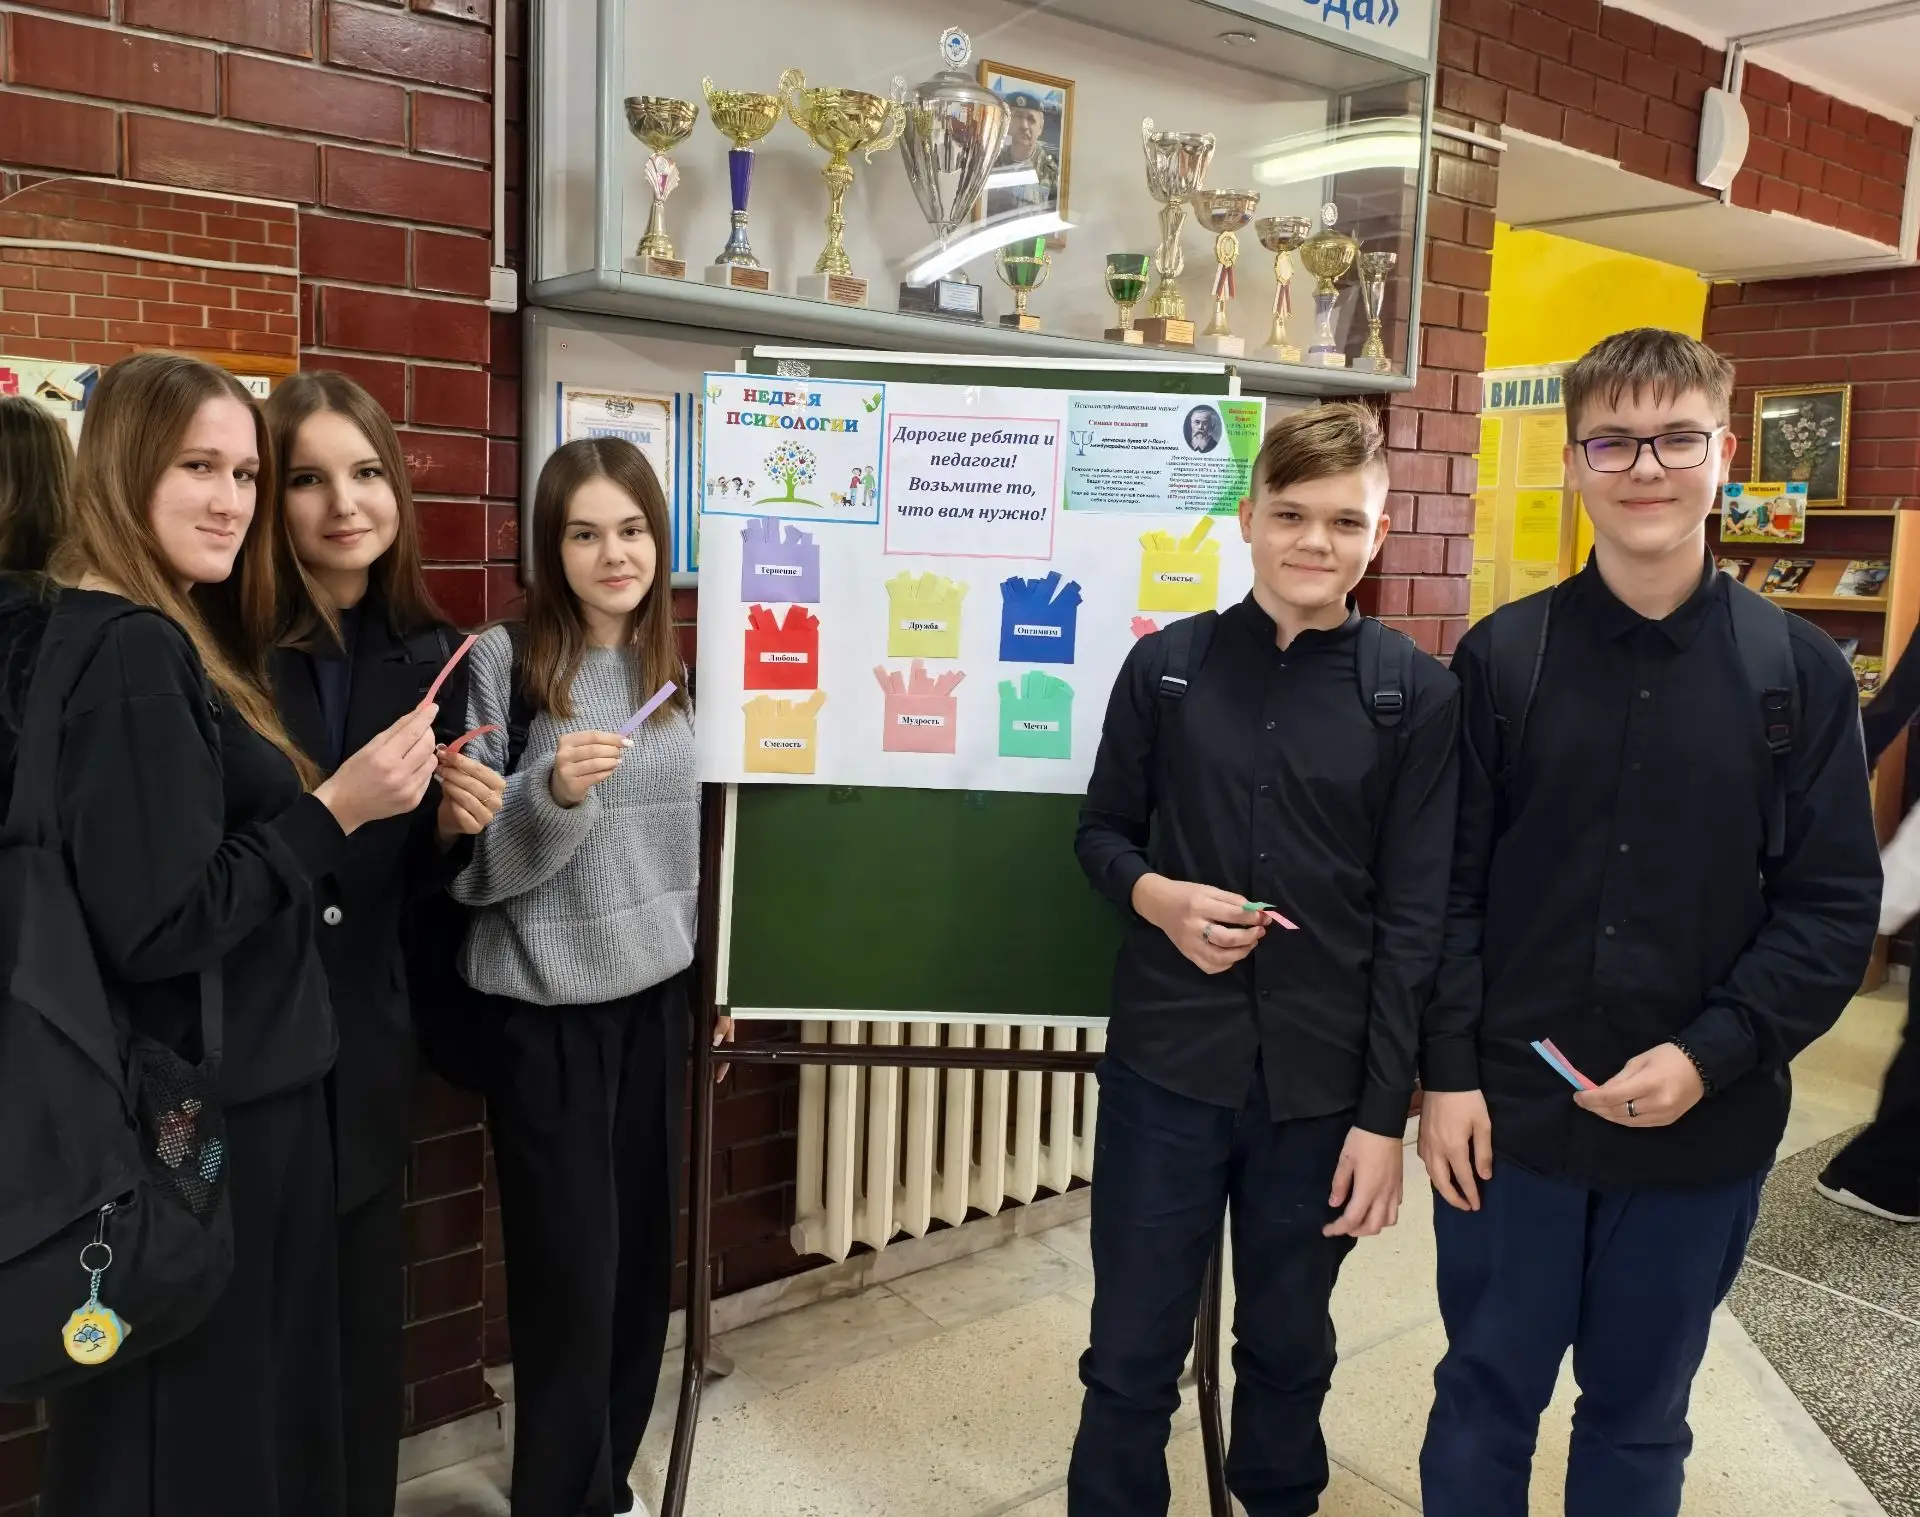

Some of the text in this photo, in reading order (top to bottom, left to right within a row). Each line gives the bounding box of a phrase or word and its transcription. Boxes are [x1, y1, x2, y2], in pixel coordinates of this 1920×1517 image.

[1304, 0, 1399, 30] да»
[726, 411, 859, 433] ПСИХОЛОГИИ
[892, 426, 1055, 447] Дорогие ребята и
[930, 453, 1018, 469] педагоги!
[908, 476, 1037, 498] Возьмите то,
[897, 505, 1047, 523] что вам нужно!
[1160, 574, 1194, 582] Счастье
[908, 621, 939, 631] Дружба
[1017, 627, 1058, 636] Оптимизм
[768, 654, 800, 662] Любовь
[902, 716, 940, 726] Мудрость
[1023, 722, 1048, 730] Мечта
[764, 740, 802, 748] Смелость
